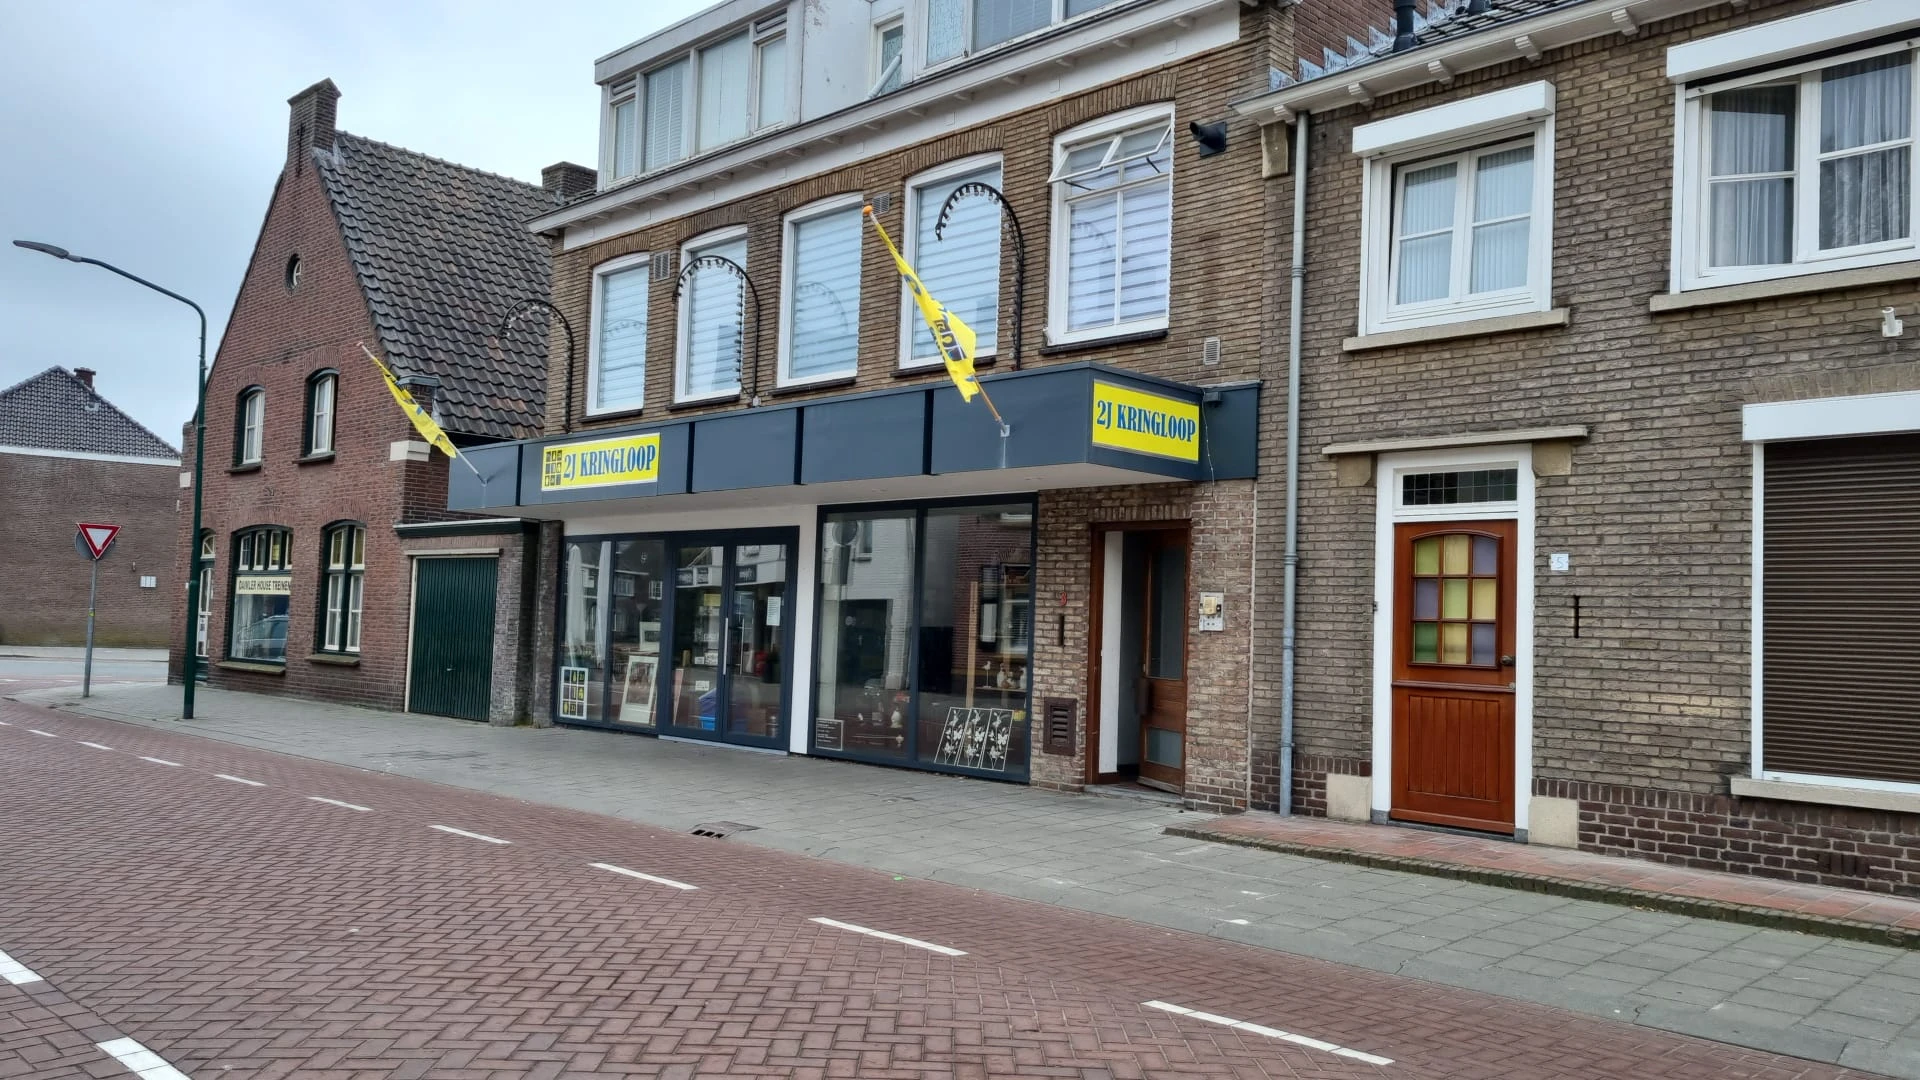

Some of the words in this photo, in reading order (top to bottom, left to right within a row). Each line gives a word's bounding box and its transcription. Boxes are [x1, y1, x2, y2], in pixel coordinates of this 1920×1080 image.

[1097, 400, 1112, 429] 2J
[1117, 404, 1196, 442] KRINGLOOP
[563, 453, 576, 481] 2J
[580, 444, 656, 477] KRINGLOOP
[1556, 556, 1564, 569] 5
[257, 580, 272, 591] HOUSE
